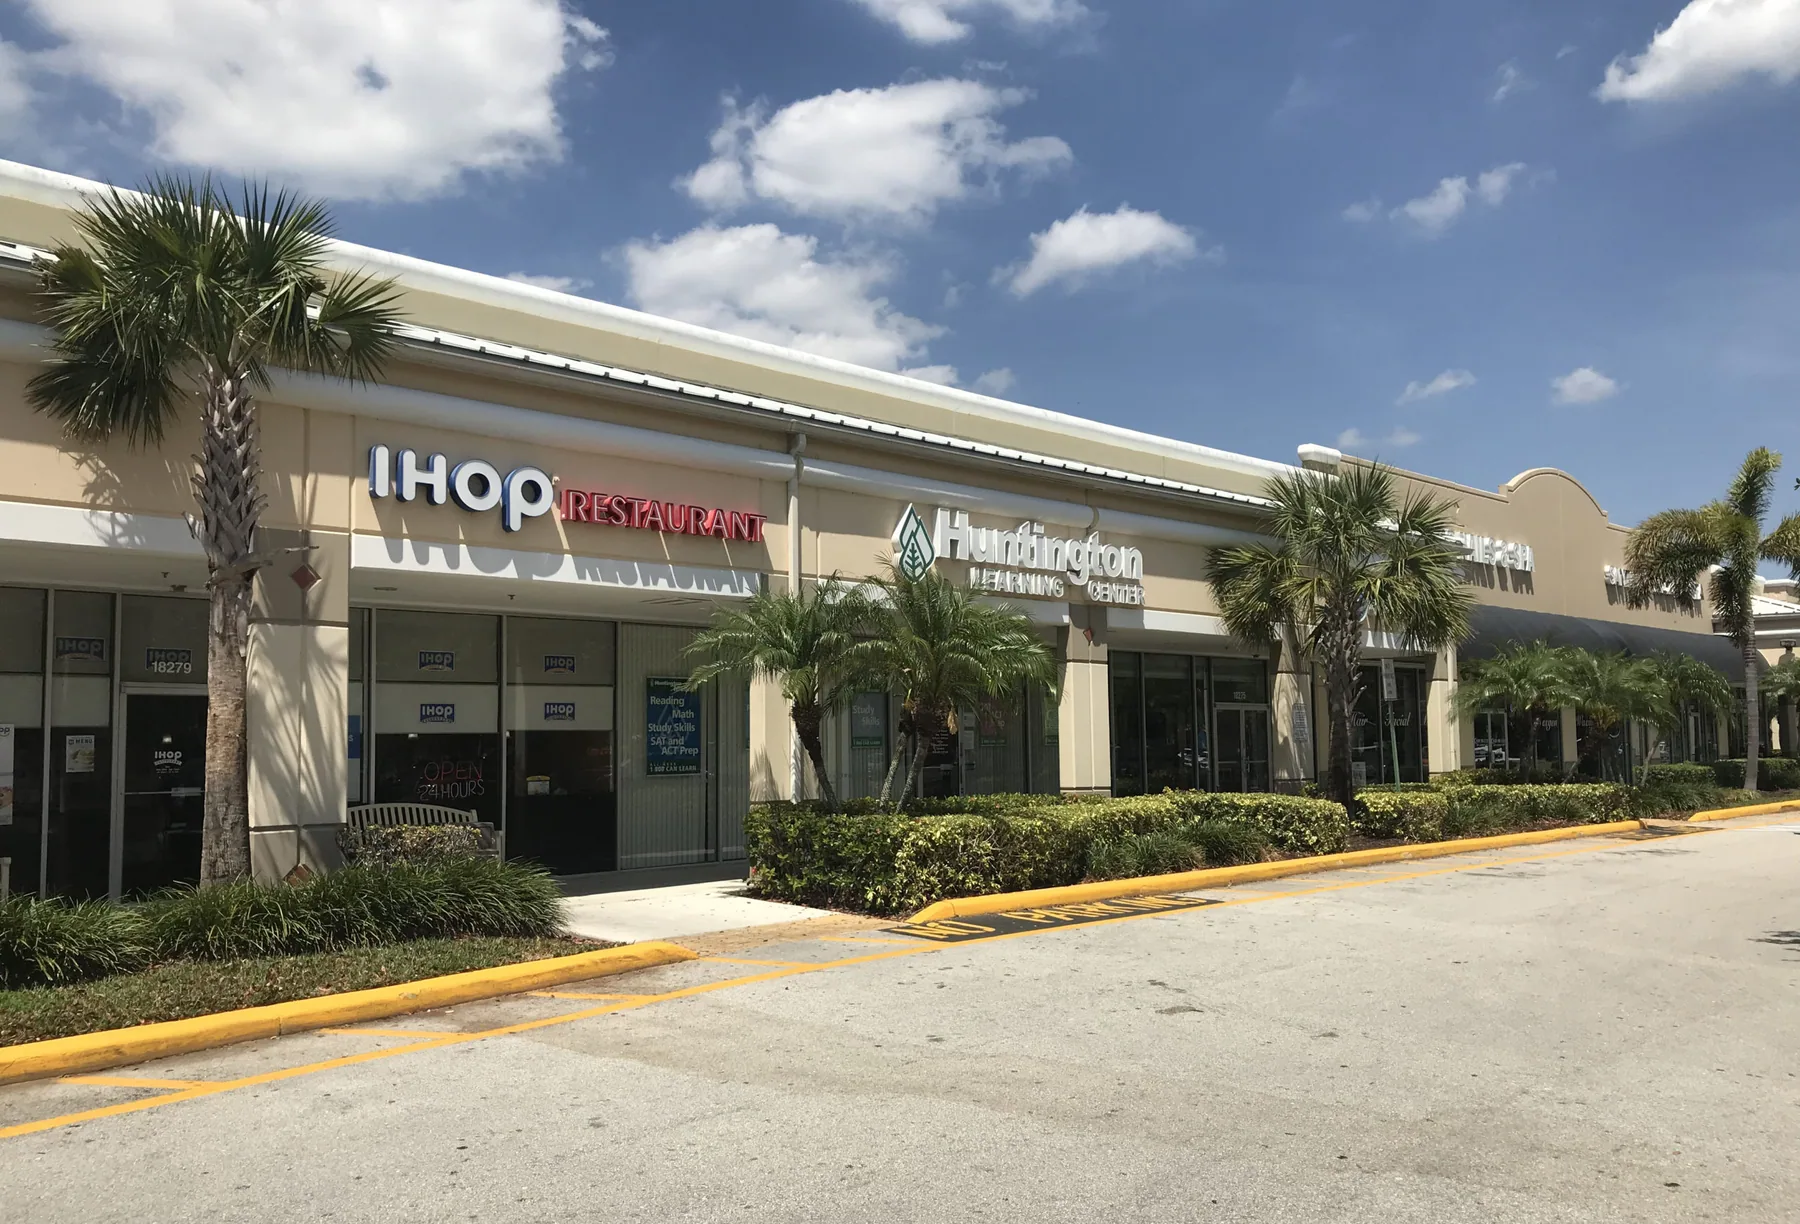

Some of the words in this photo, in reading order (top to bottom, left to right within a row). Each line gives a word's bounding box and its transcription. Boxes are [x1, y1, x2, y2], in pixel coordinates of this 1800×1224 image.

[369, 444, 554, 532] IHOP
[560, 489, 767, 543] RESTAURANT
[933, 507, 1144, 586] Huntington
[970, 567, 1064, 598] LEARNING
[1088, 580, 1146, 605] CENTER
[152, 661, 192, 674] 18279
[650, 696, 685, 707] Reading
[672, 710, 695, 719] Math
[648, 723, 672, 734] Study
[674, 723, 696, 732] Skills
[650, 736, 666, 746] SAT
[668, 736, 685, 745] and
[154, 751, 182, 761] IHOP
[661, 746, 678, 755] ACT
[680, 746, 699, 756] Prep
[424, 761, 483, 781] OPEN
[419, 784, 438, 801] 24
[441, 779, 485, 800] HOURS
[891, 920, 996, 938] NO
[1000, 895, 1207, 923] PARKING
